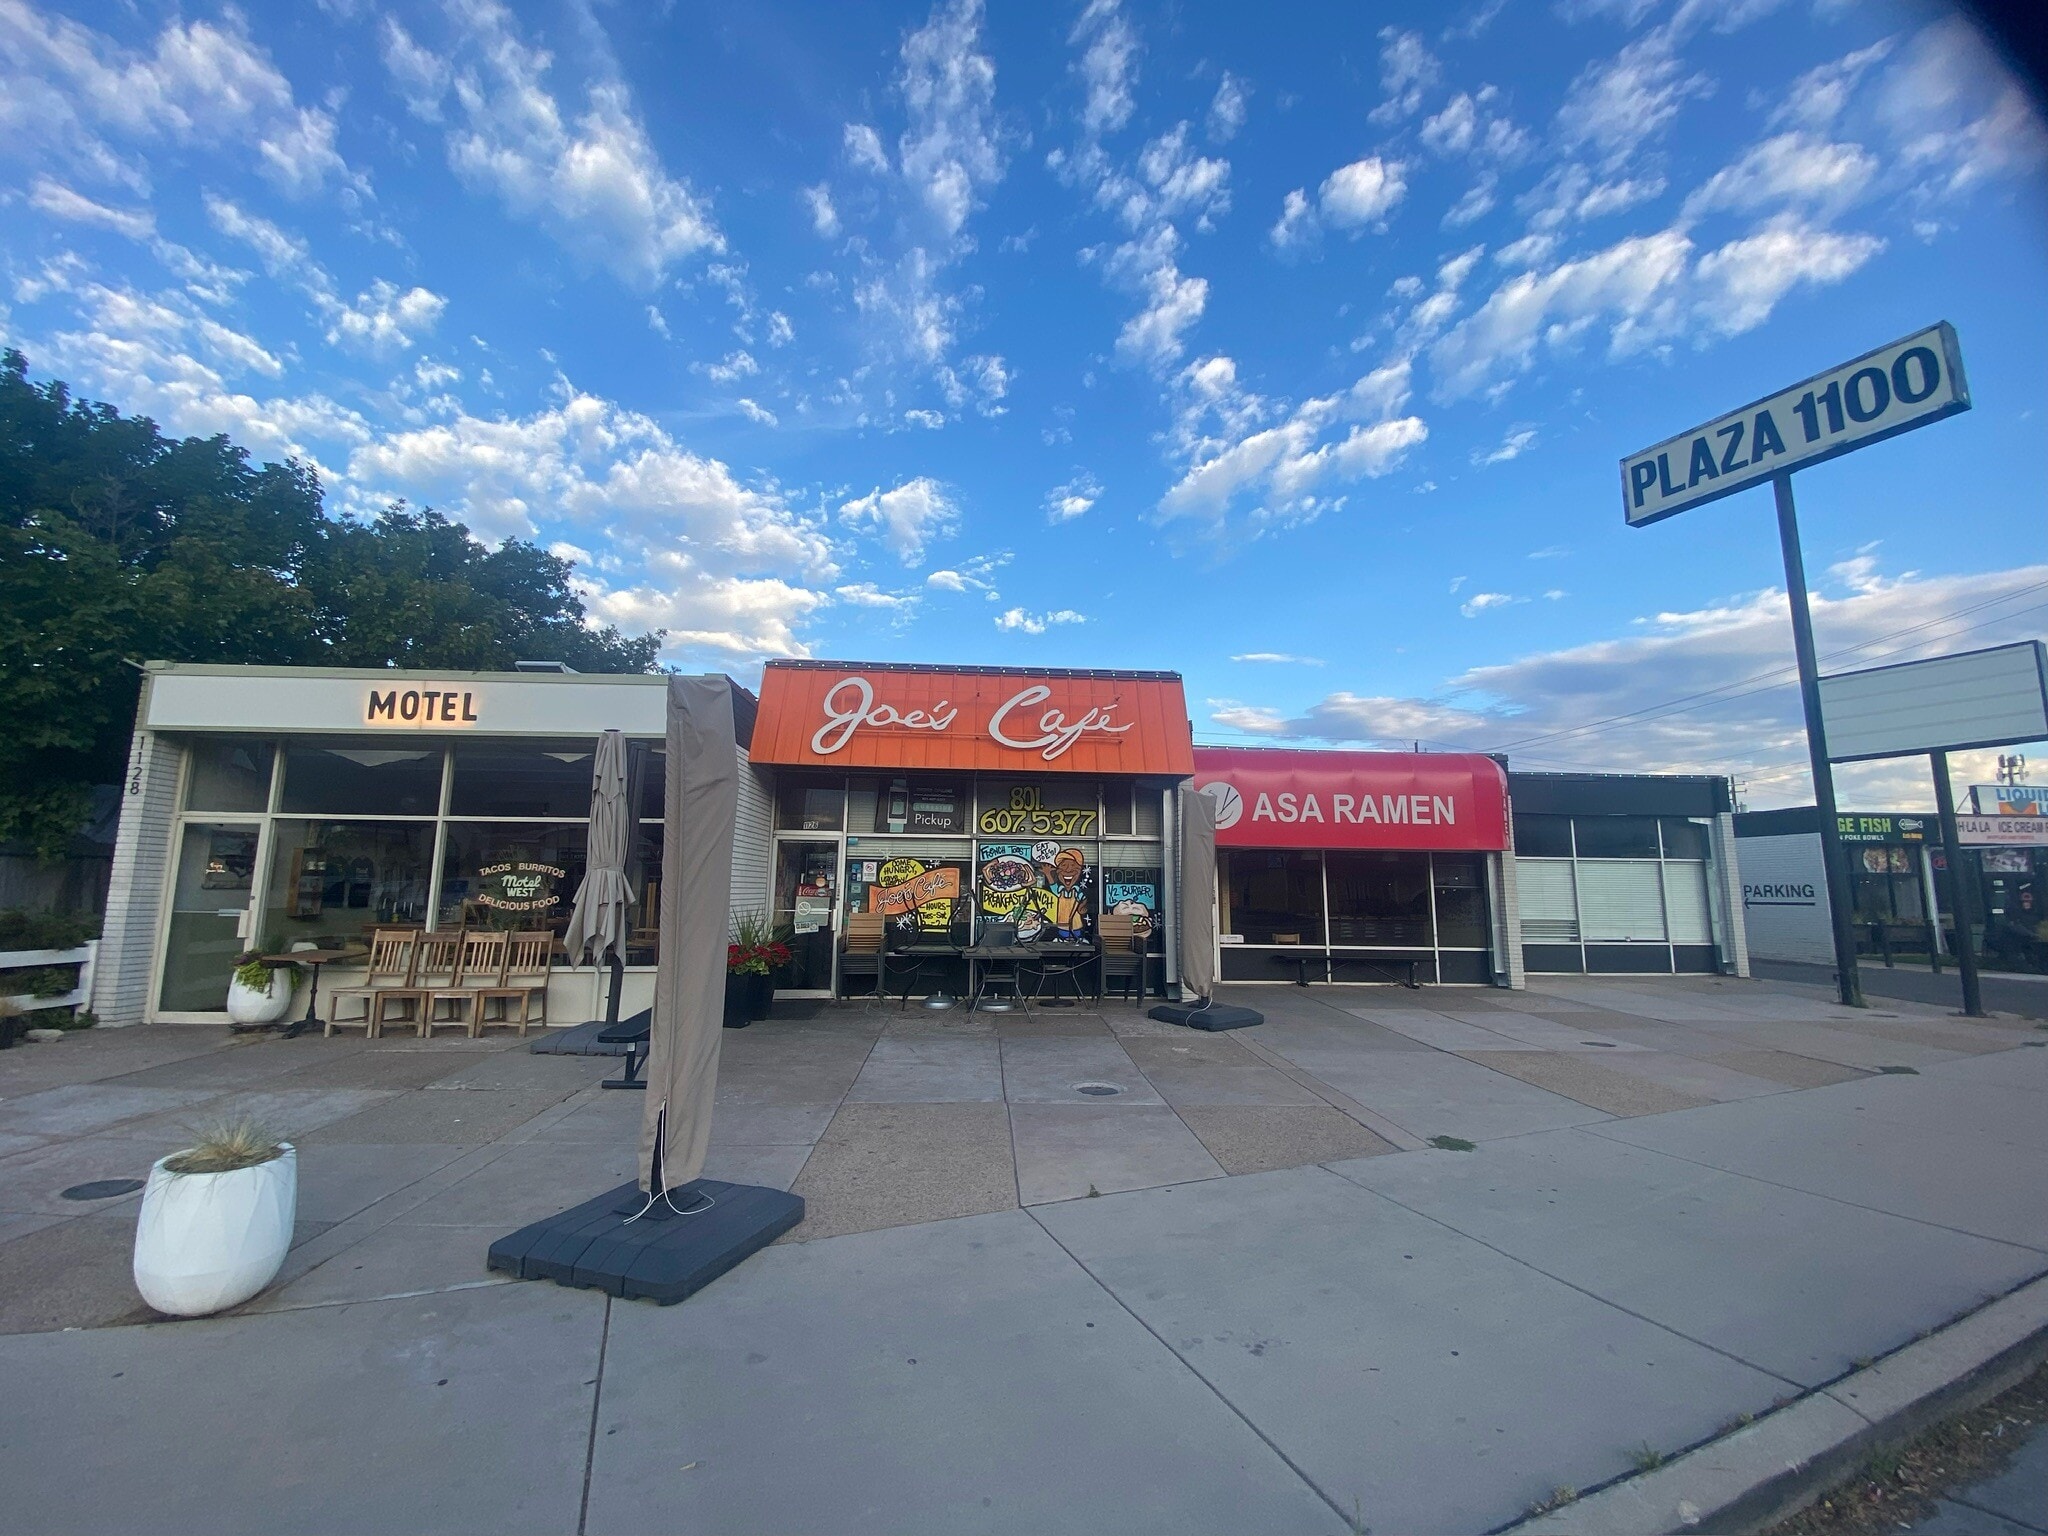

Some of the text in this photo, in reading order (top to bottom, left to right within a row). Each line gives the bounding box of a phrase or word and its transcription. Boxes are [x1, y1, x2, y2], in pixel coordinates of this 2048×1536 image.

[1630, 347, 1940, 508] PLAZA 1100
[368, 691, 478, 721] MOTEL
[811, 677, 1135, 761] Joe's Café
[130, 736, 145, 795] 1128
[1252, 792, 1456, 825] ASA RAMEN
[915, 813, 952, 829] Pickup
[1860, 817, 1891, 832] FISH
[2014, 821, 2044, 833] CREAM
[479, 863, 566, 878] TACOS BURRITOS
[501, 875, 541, 887] Motel
[507, 888, 535, 897] WEST
[1743, 884, 1815, 898] PARKING
[478, 893, 560, 911] DELICIOUS FOOD
